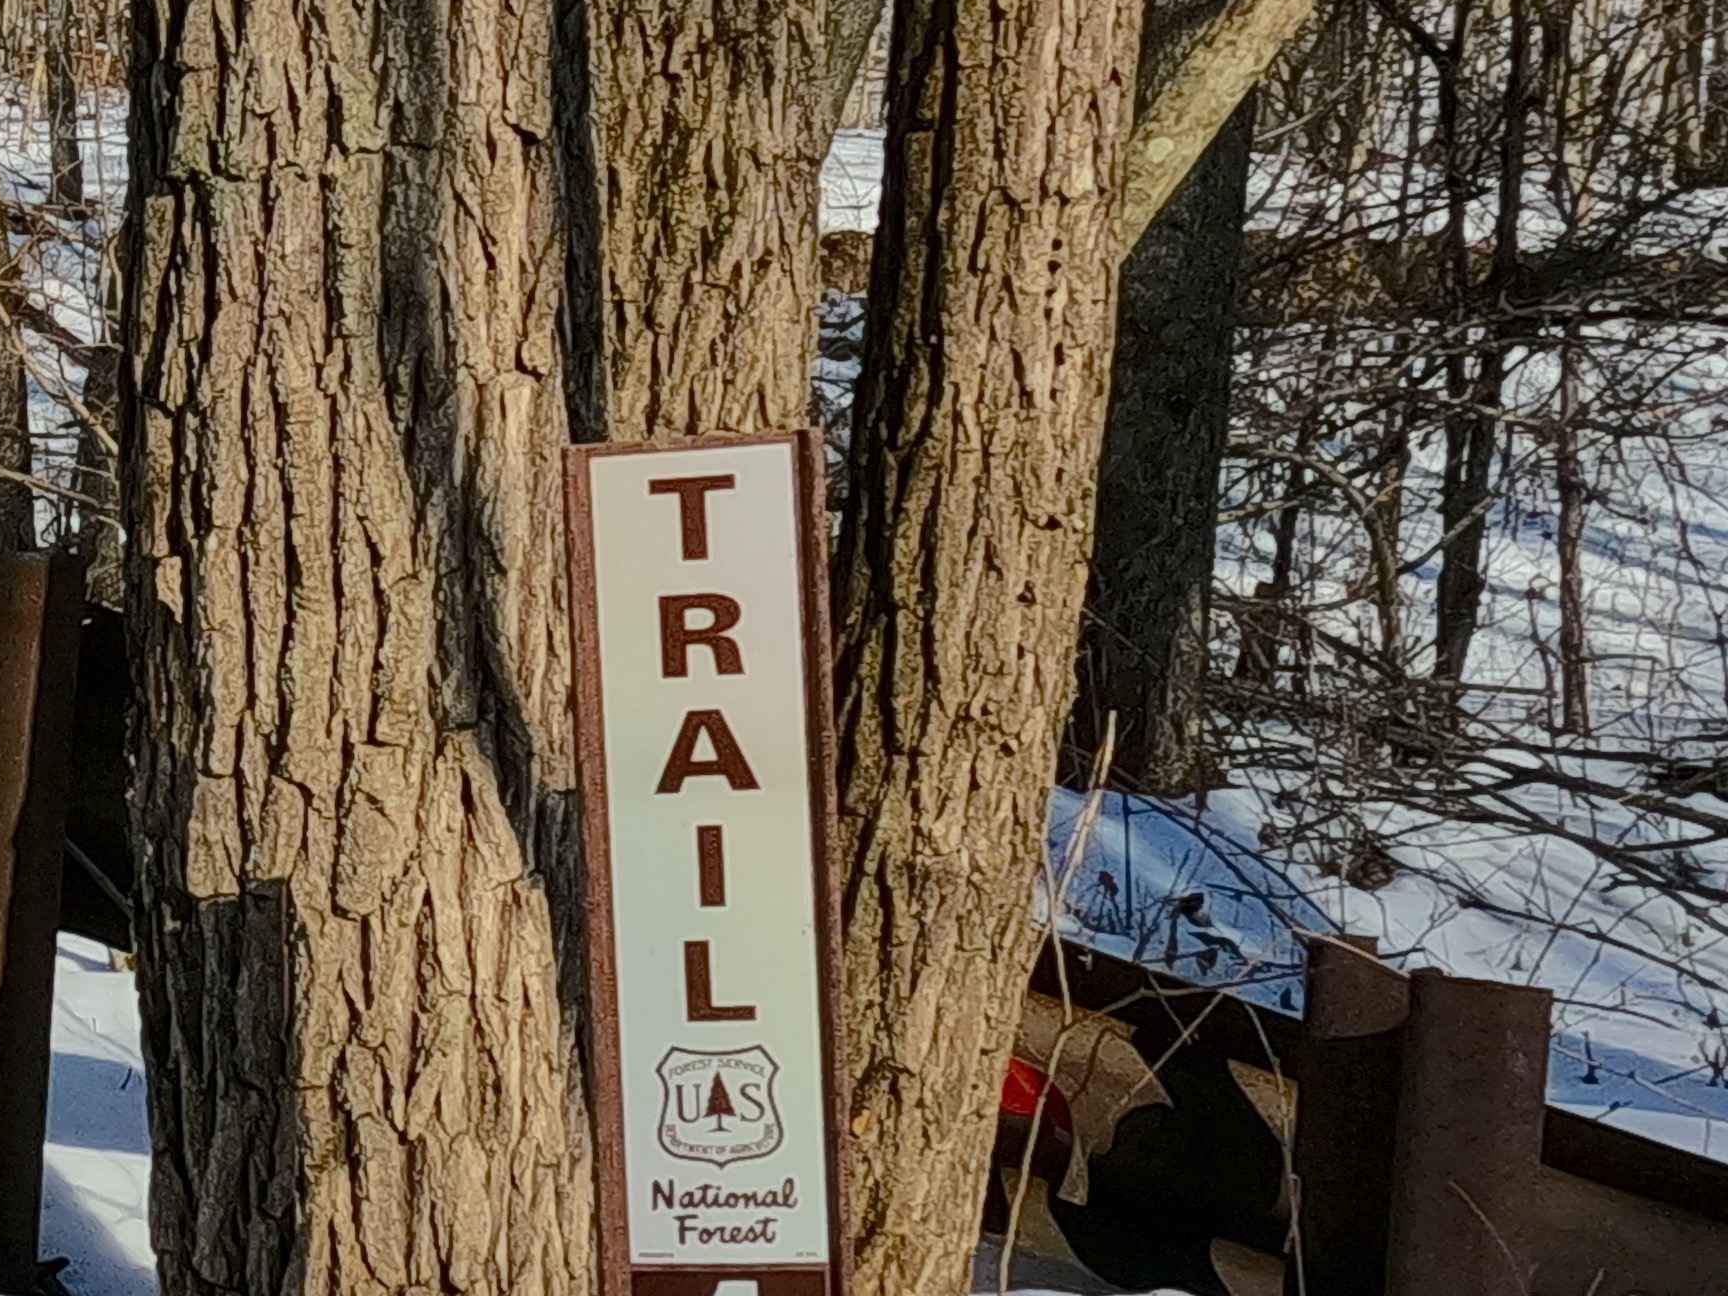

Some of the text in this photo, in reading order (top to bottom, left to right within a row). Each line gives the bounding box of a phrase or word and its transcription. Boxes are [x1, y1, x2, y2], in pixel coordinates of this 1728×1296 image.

[648, 473, 761, 1023] TRAIL
[669, 1057, 766, 1078] FOREST SERVICE
[652, 1177, 798, 1211] National
[673, 1215, 778, 1245] Forest
